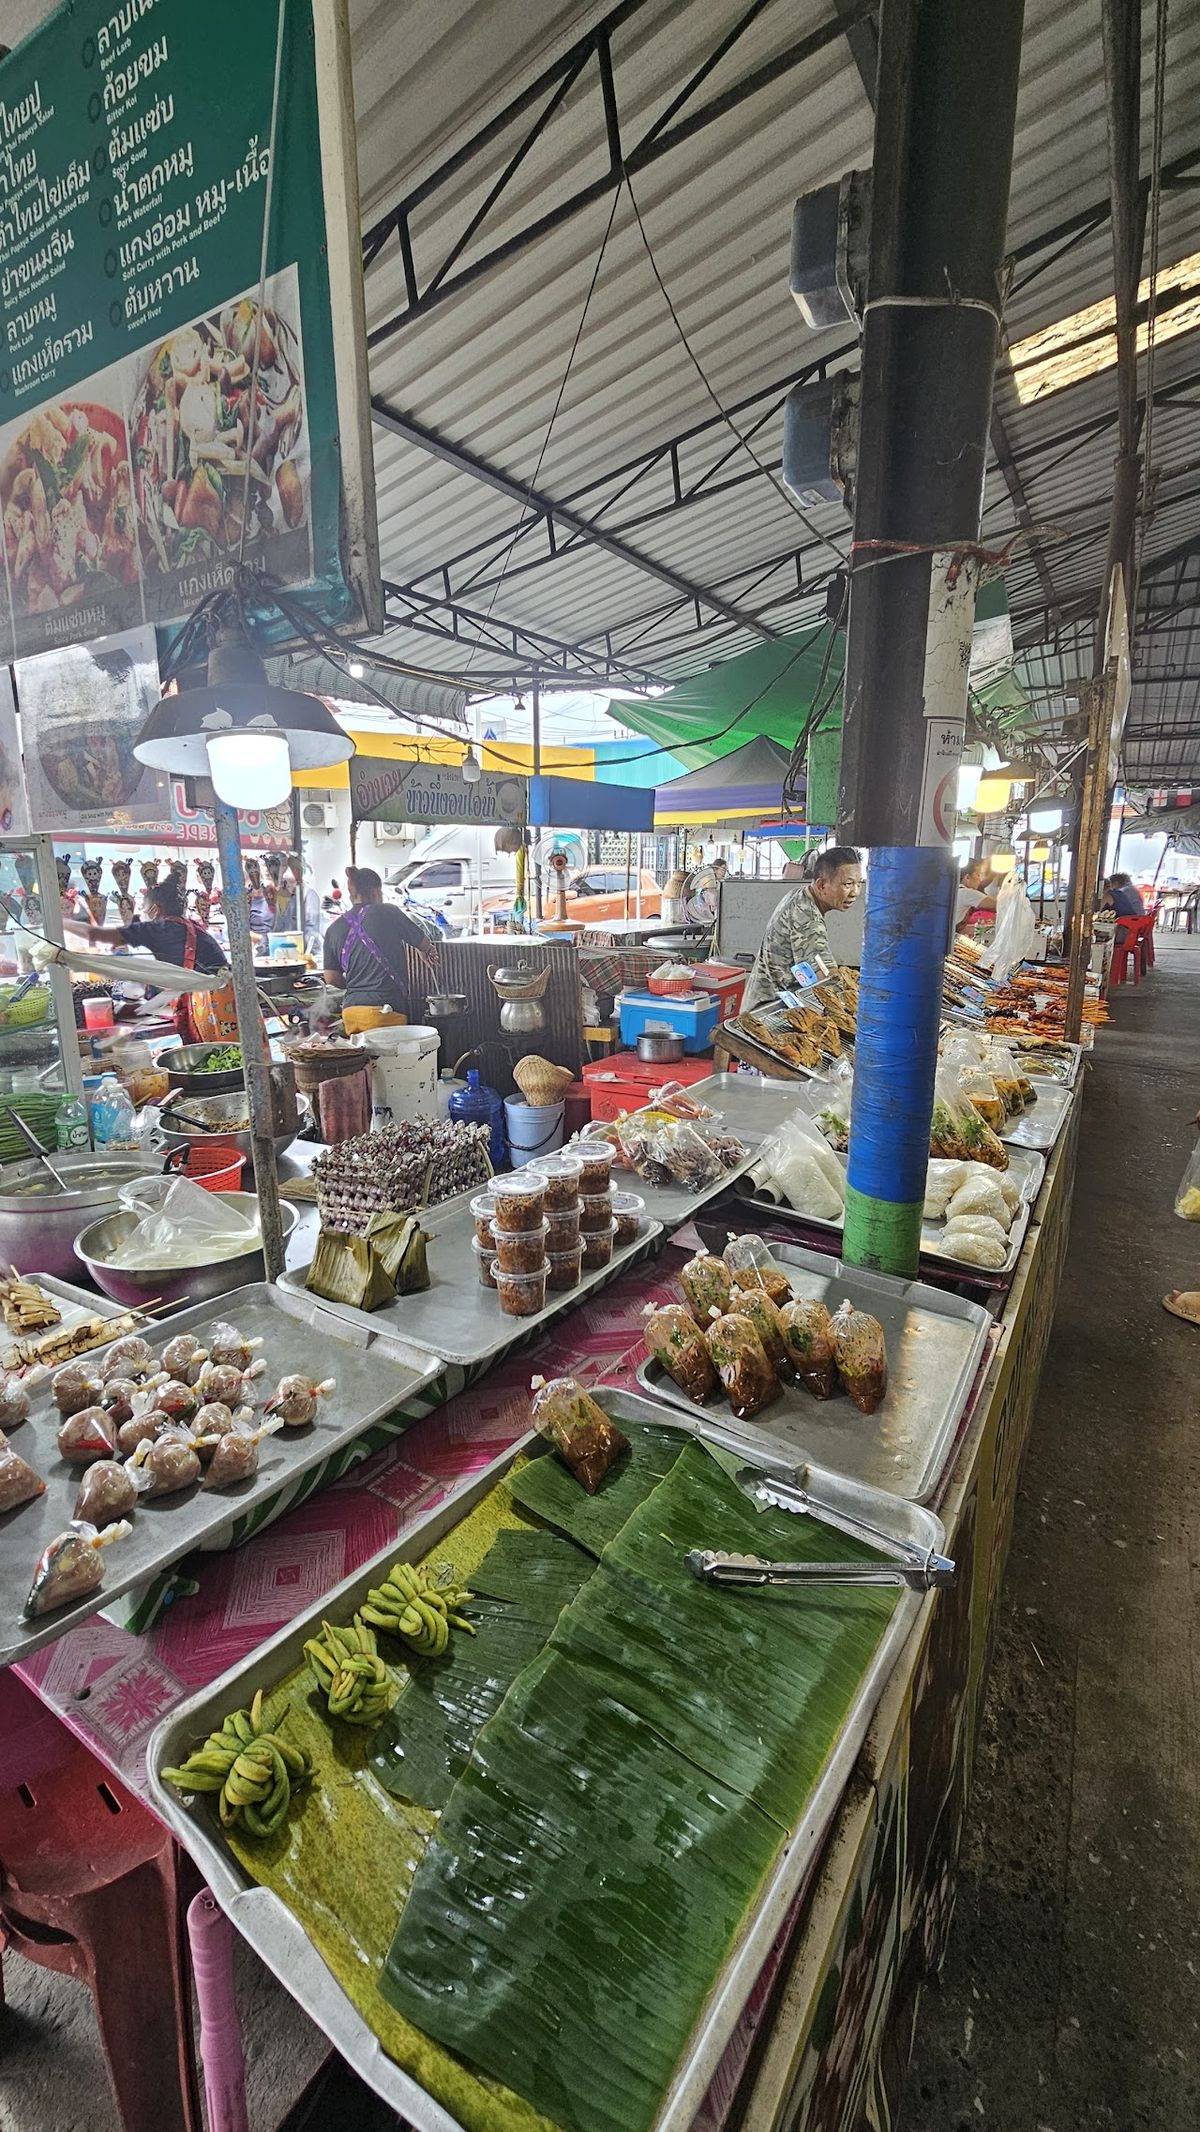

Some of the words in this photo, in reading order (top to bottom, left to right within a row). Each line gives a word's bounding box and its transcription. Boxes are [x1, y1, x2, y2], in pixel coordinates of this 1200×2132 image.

[101, 50, 115, 71] Beef
[116, 37, 131, 56] Larb
[103, 35, 168, 111] ก้อยขม
[106, 105, 125, 125] Bitter
[108, 93, 175, 163] ต้มแซ่บ
[130, 147, 148, 165] Soup
[113, 141, 194, 216] น้ำตกหมู
[58, 199, 78, 219] Salted
[77, 191, 90, 205] Egg
[117, 214, 133, 231] Pork
[132, 192, 163, 220] Waterfall
[119, 202, 191, 268] แกงอ่อม
[122, 267, 136, 282] Soft
[136, 256, 155, 273] Curry
[155, 245, 171, 261] with
[171, 234, 188, 251] Pork
[188, 223, 203, 241] and
[203, 211, 221, 231] Beef
[1, 228, 75, 297] ยำขนมจีน
[18, 287, 30, 300] Rice
[30, 273, 50, 292] Noodle
[49, 259, 66, 278] Salad
[124, 256, 200, 319] ตับหวาน
[7, 292, 57, 342] ลาบหมู
[147, 306, 162, 321] liver
[9, 343, 21, 354] Pork
[21, 332, 34, 346] Larb
[12, 320, 93, 386] แกงเห็ดรวม
[15, 377, 40, 397] Mushroom
[40, 367, 56, 382] Curry
[178, 554, 266, 598] แกงเห็ดวม
